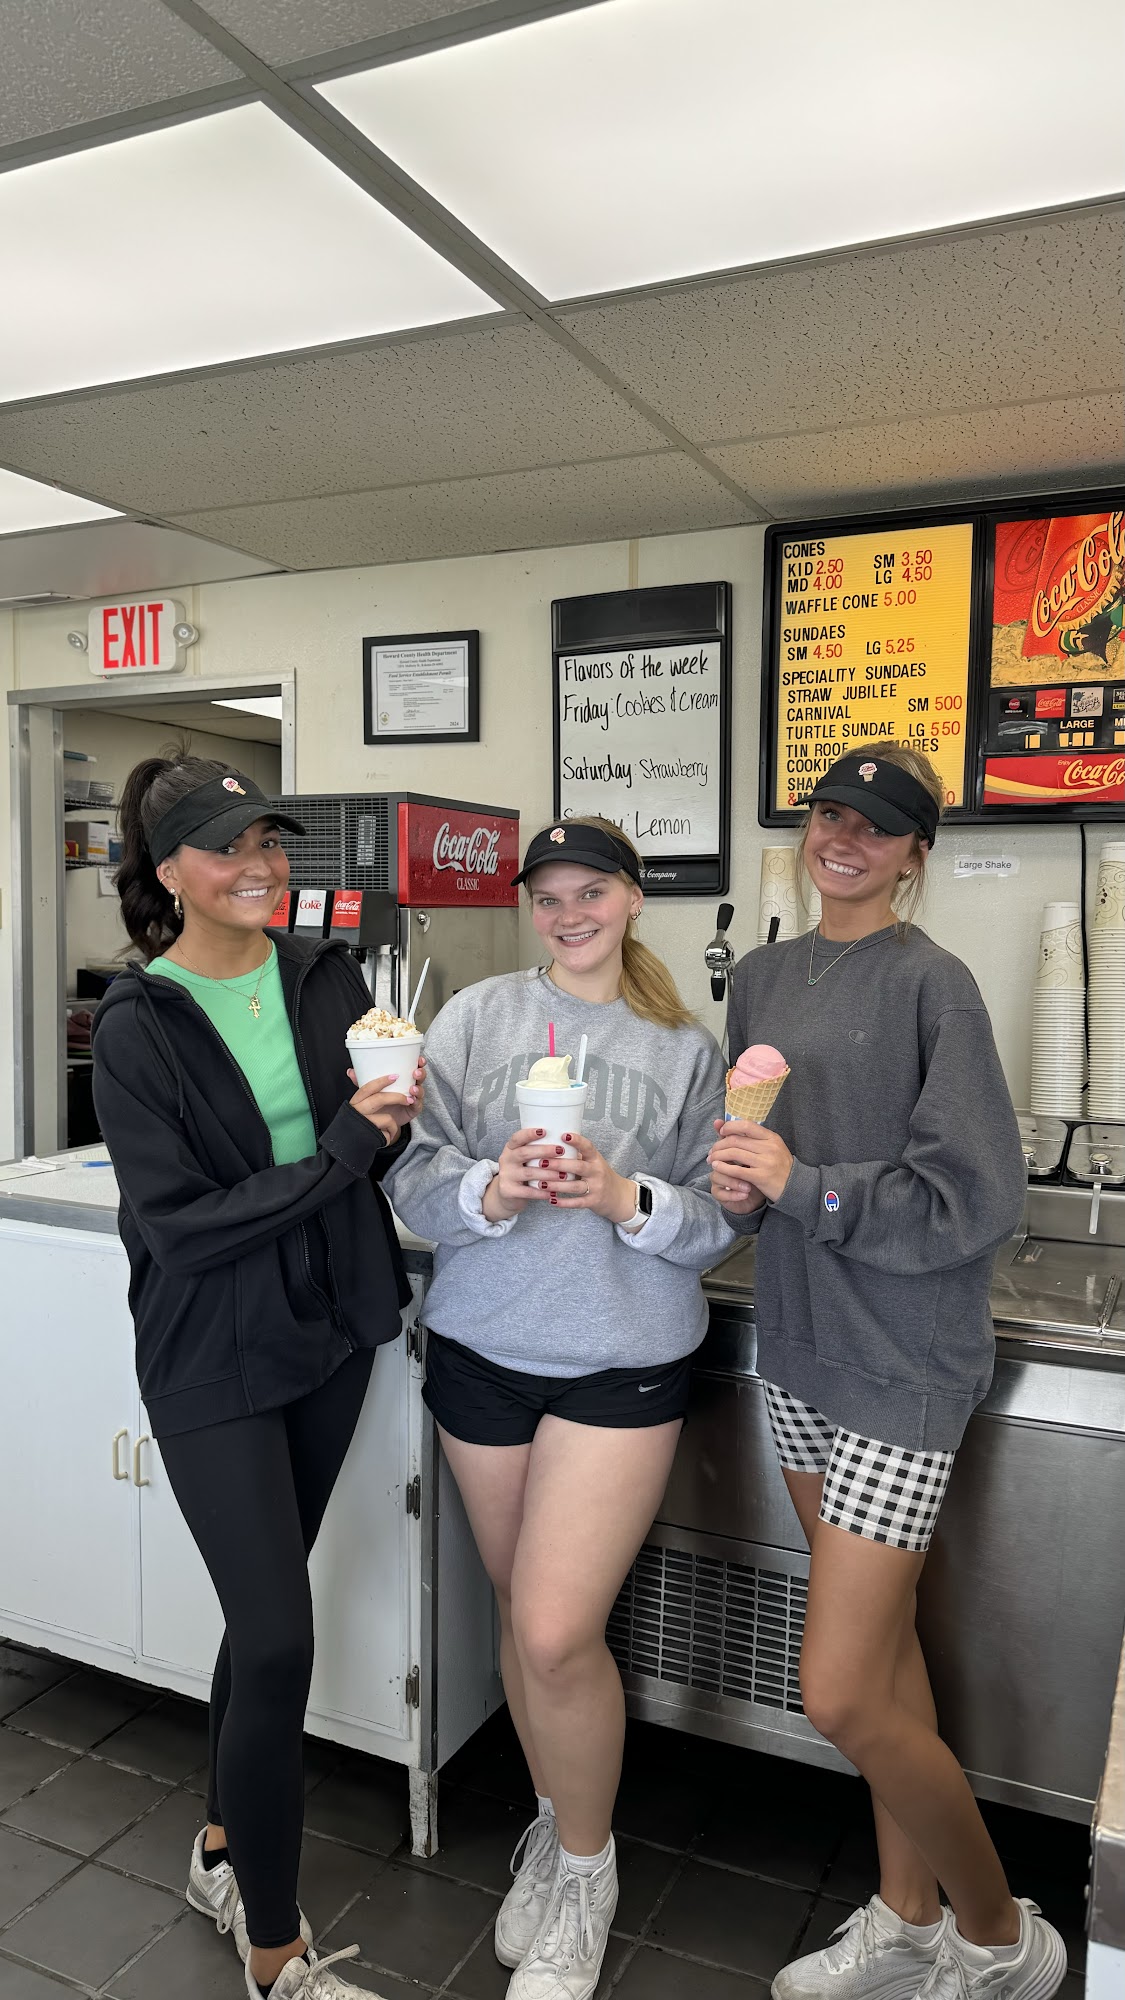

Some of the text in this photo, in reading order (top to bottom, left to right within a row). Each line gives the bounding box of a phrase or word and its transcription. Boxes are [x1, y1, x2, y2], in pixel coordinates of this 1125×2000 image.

[784, 542, 825, 559] CONES
[788, 550, 933, 577] KID 2.50 SM 3.50
[1032, 511, 1125, 638] Coca-Col
[787, 565, 933, 593] MD 4.00 LG 4.50
[785, 590, 917, 615] WAFFLE CONE 5.00
[1076, 587, 1101, 614] CLASSIC
[103, 603, 164, 669] EXIT
[783, 624, 846, 643] SUNDAES
[787, 638, 915, 661] SM 4.50 LG 5.25
[564, 649, 709, 681] Flavors of the week
[782, 662, 926, 685] SPECIALITY SUNDAES
[787, 683, 897, 704] STRAW JUBILEE
[907, 695, 963, 712] SM 500
[563, 694, 614, 731] Friday:
[787, 705, 851, 722] CARNIVAL
[786, 721, 895, 740] TURTLE SUNDAE
[908, 720, 961, 737] LG 550
[1060, 720, 1094, 729] LARGE
[786, 742, 849, 758] TIN ROOF
[896, 738, 939, 752] ORES
[639, 758, 709, 787] Strawberry
[1064, 758, 1125, 787] Coca-Co
[635, 811, 691, 838] Lemon
[432, 822, 500, 875] Coca-Cola
[647, 869, 677, 880] Company
[958, 860, 1012, 870] Large Shake
[456, 877, 480, 891] CLASSIC
[300, 900, 322, 910] Coke
[476, 1053, 667, 1161] PUDUE
